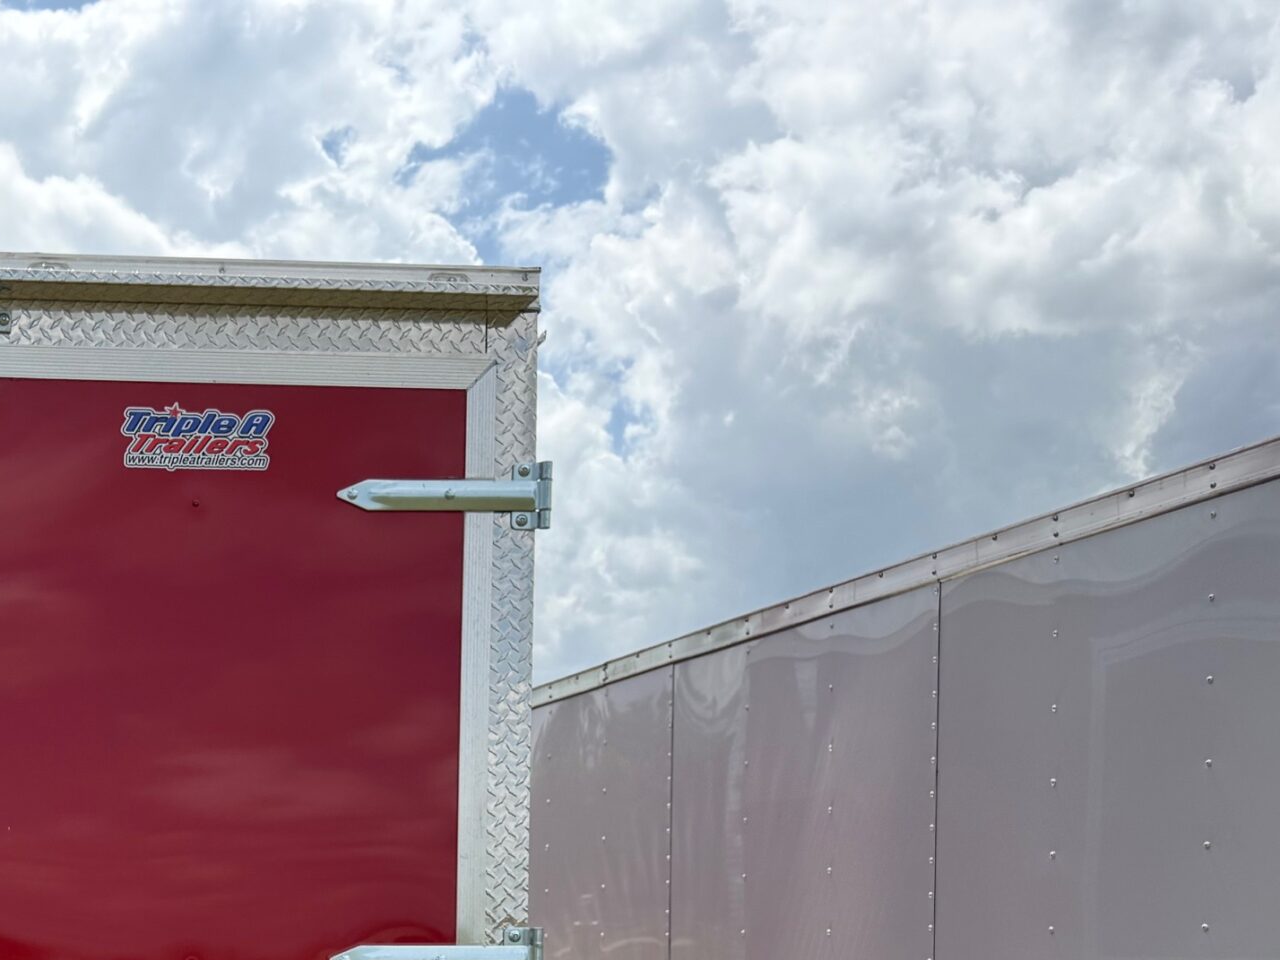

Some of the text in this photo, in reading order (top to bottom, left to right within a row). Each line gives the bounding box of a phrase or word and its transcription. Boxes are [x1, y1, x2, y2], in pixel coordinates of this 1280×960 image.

[123, 410, 273, 437] Triple A
[128, 433, 265, 456] Trailers
[127, 454, 267, 469] www.tripleatrailers.com
